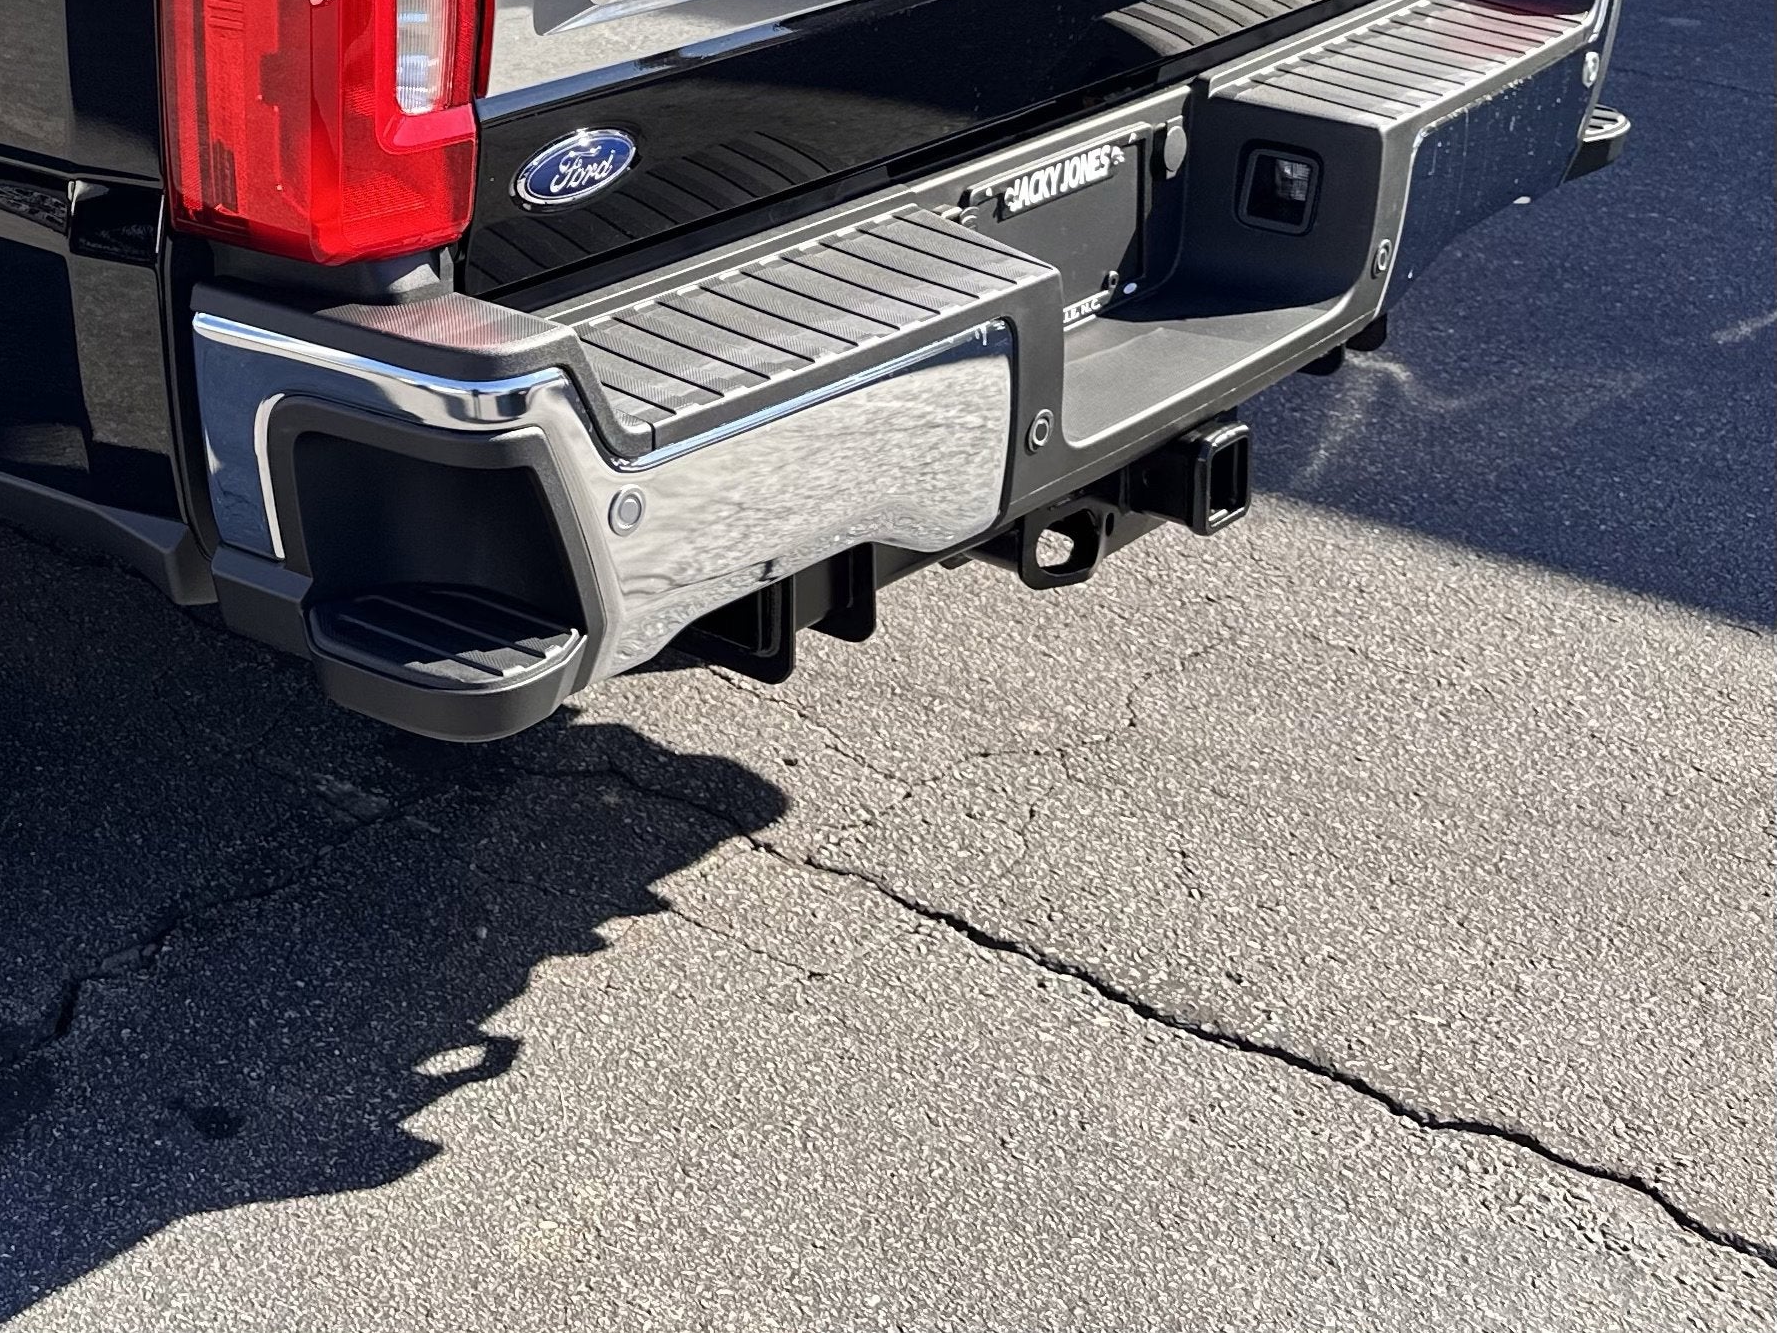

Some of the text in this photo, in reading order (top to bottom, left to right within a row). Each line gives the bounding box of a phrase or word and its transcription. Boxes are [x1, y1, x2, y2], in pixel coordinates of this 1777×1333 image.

[549, 145, 617, 193] Ford
[1009, 144, 1112, 212] JACKY JONES
